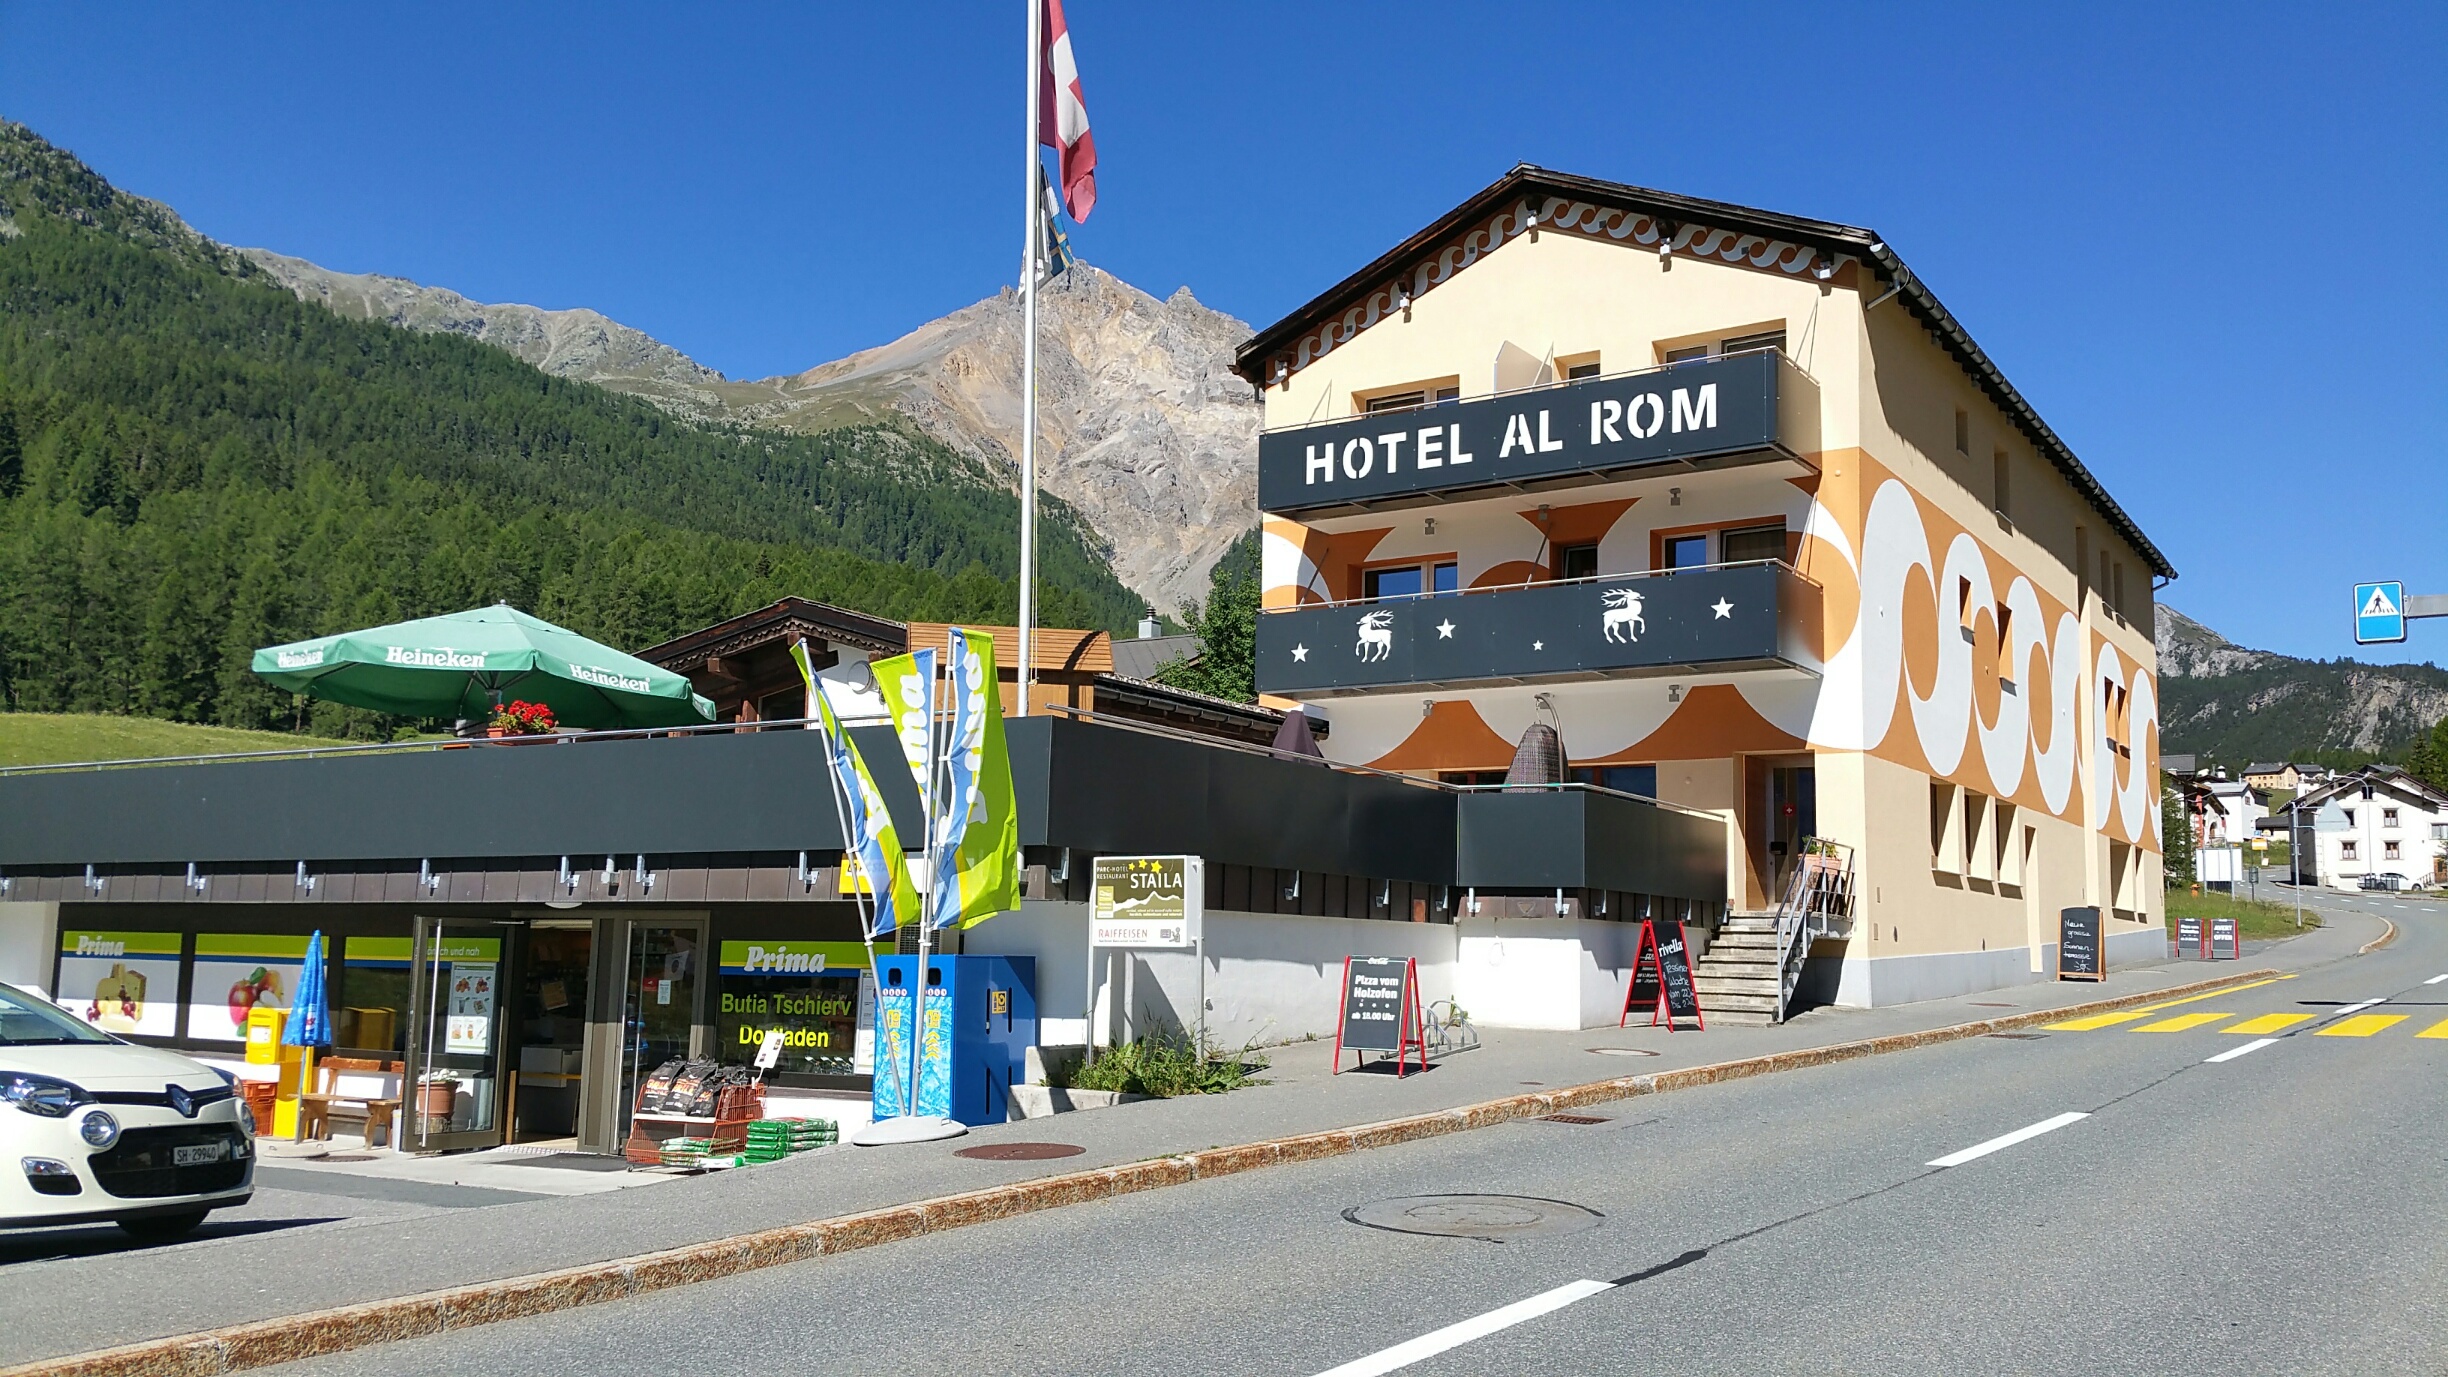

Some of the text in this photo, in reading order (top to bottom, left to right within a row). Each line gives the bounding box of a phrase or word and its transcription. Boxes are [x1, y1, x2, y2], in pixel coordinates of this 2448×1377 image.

[1305, 383, 1718, 486] HOTEL AL ROM
[278, 647, 324, 669] Heineken
[385, 646, 489, 668] Heineken
[568, 663, 651, 692] Heineken
[1130, 872, 1183, 889] STAILA
[1098, 929, 1148, 939] RAIFFEISEN
[76, 935, 125, 956] Prima
[1658, 938, 1684, 957] rivella
[744, 946, 826, 973] Prima
[1354, 974, 1399, 986] Pizza vom
[1668, 975, 1690, 986] Woche
[1353, 987, 1398, 999] Holzofen
[721, 993, 852, 1016] Butia Tschierv
[739, 1024, 829, 1048] Doaden
